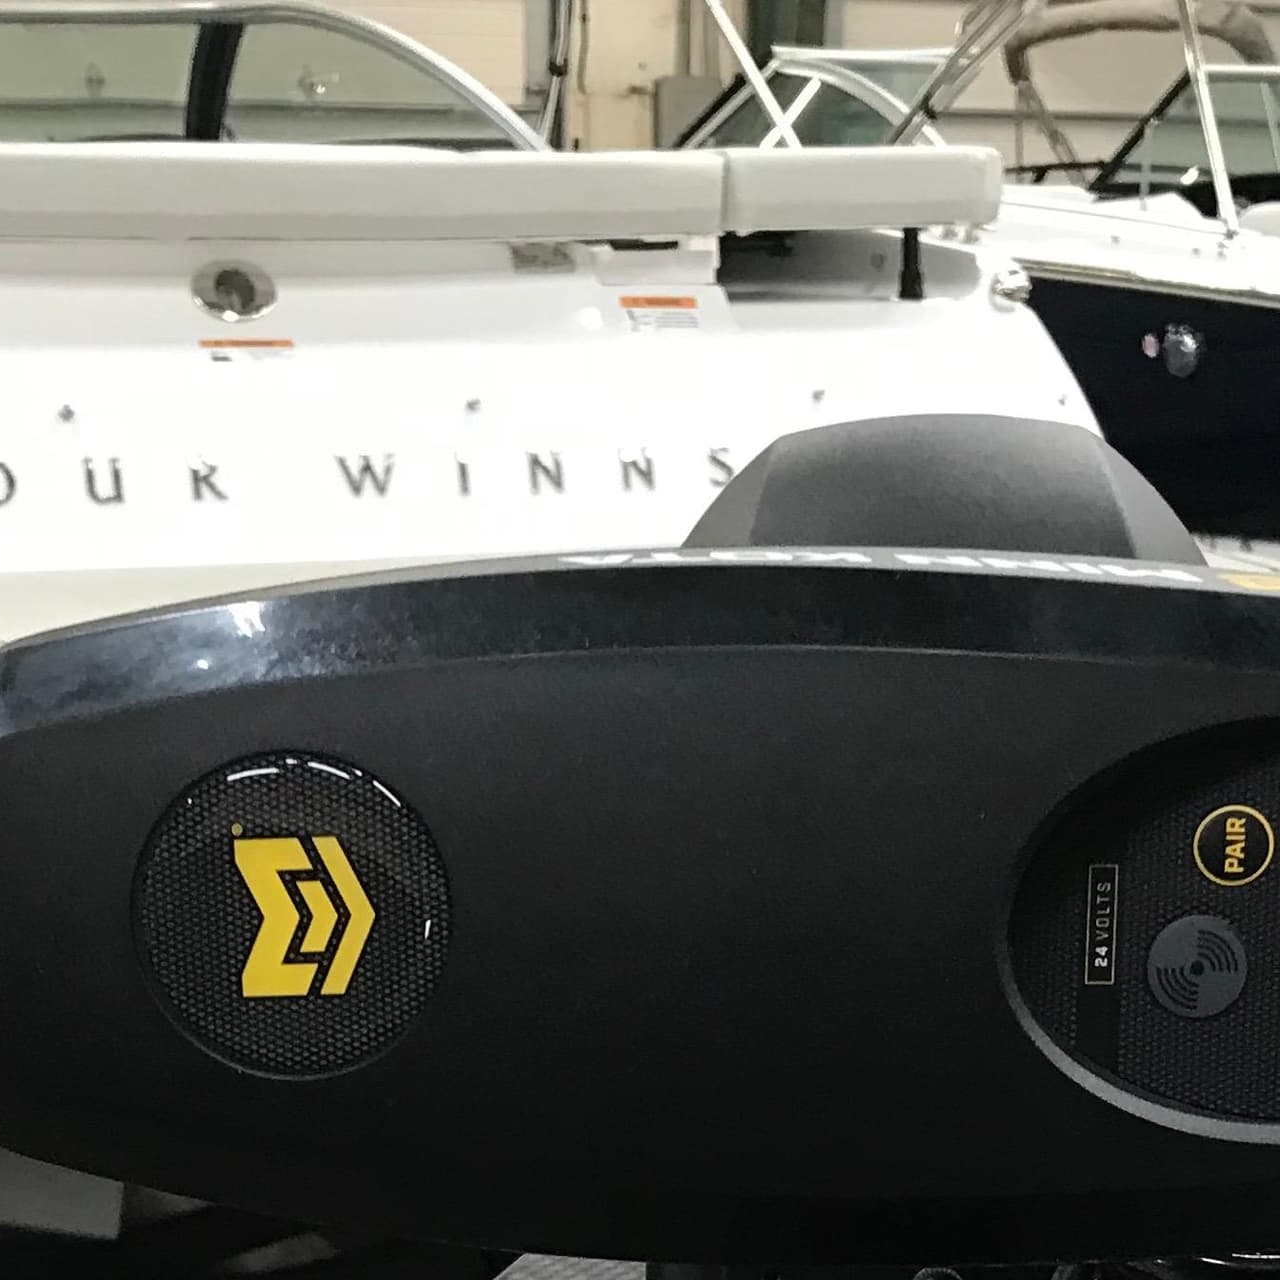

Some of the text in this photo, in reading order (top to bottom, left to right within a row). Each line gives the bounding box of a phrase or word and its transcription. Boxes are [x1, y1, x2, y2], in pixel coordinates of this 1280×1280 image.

[332, 446, 735, 498] WINNS
[1223, 816, 1247, 874] PAIR
[1093, 880, 1113, 969] 24 VOLTS
